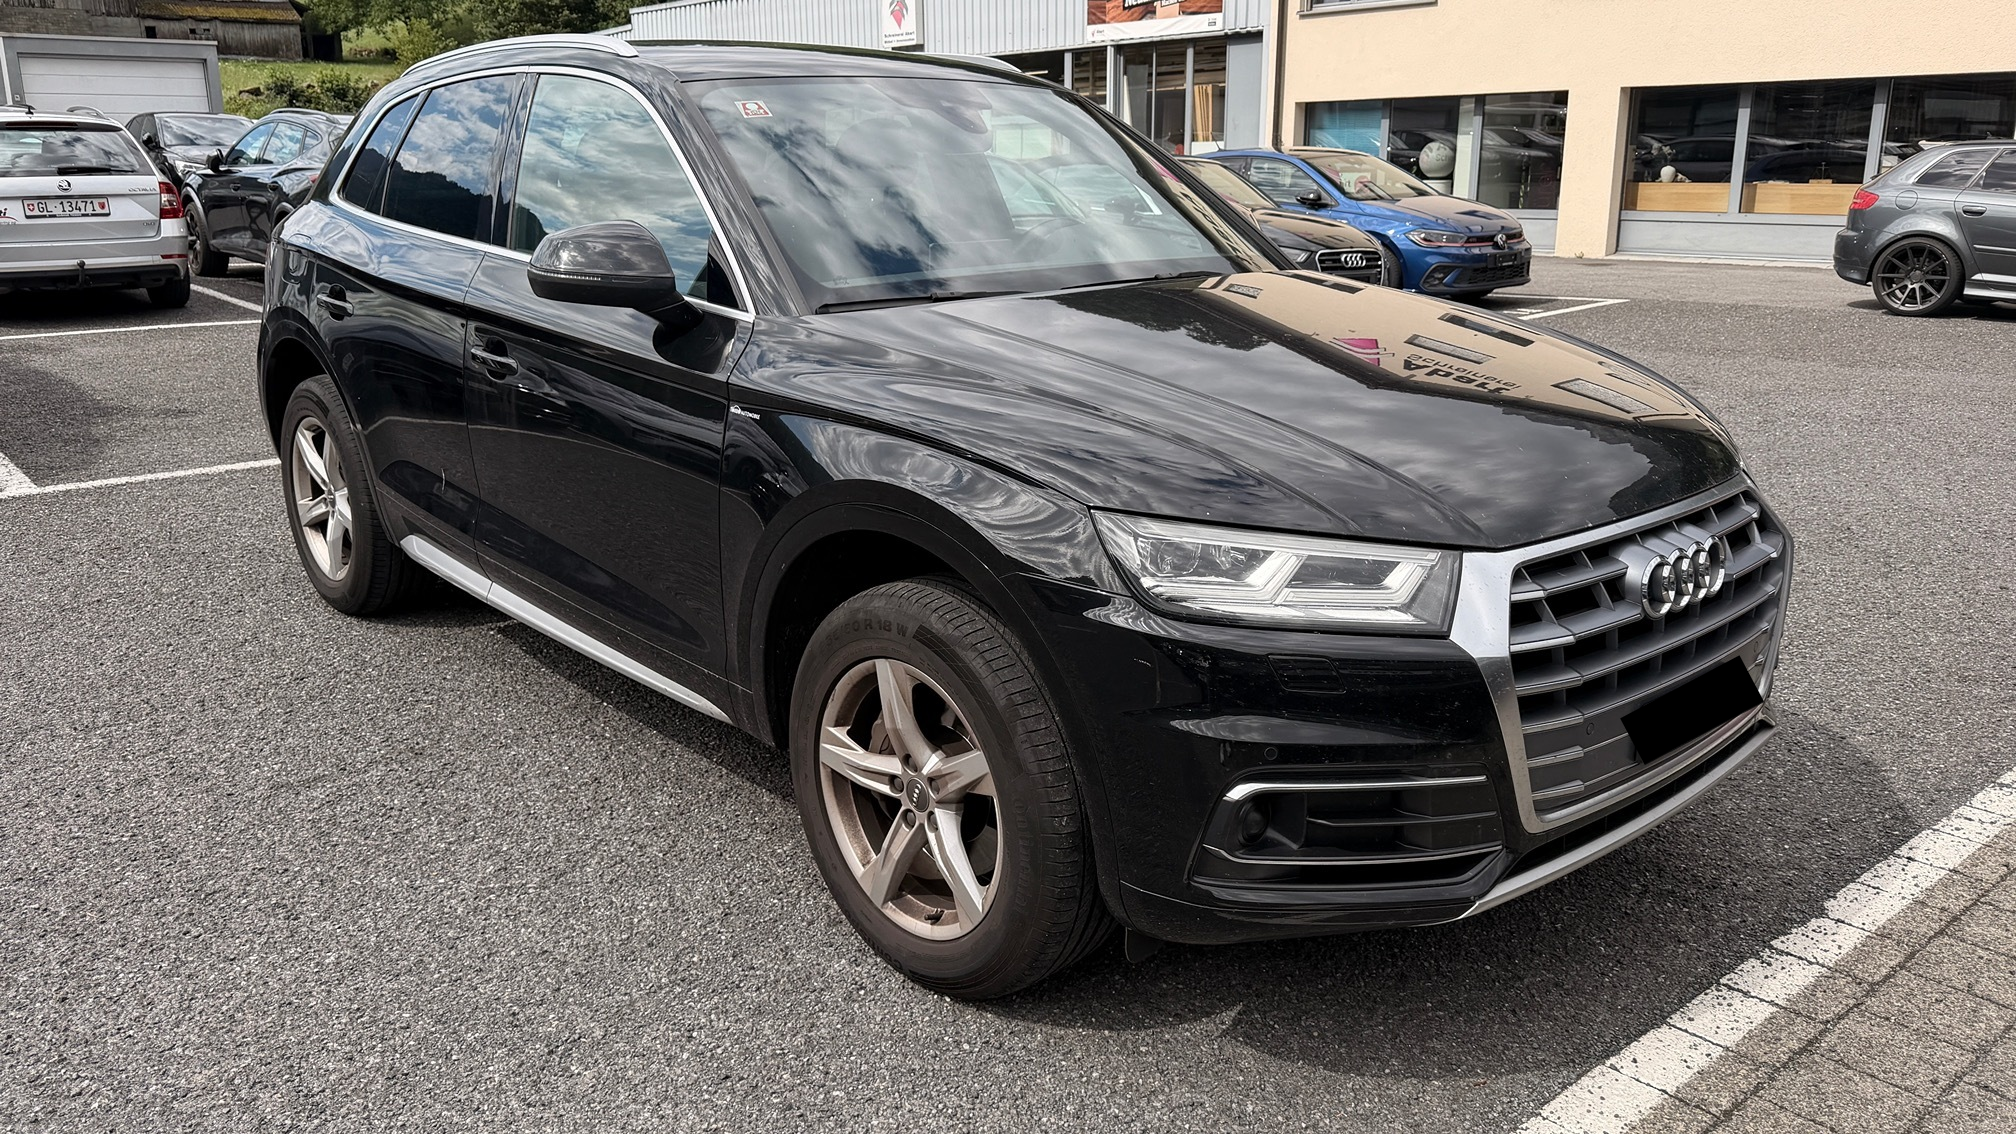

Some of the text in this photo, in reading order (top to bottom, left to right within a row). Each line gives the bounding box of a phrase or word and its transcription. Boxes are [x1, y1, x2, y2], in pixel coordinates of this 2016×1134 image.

[863, 618, 873, 631] R
[876, 619, 892, 633] 18
[896, 622, 909, 638] W
